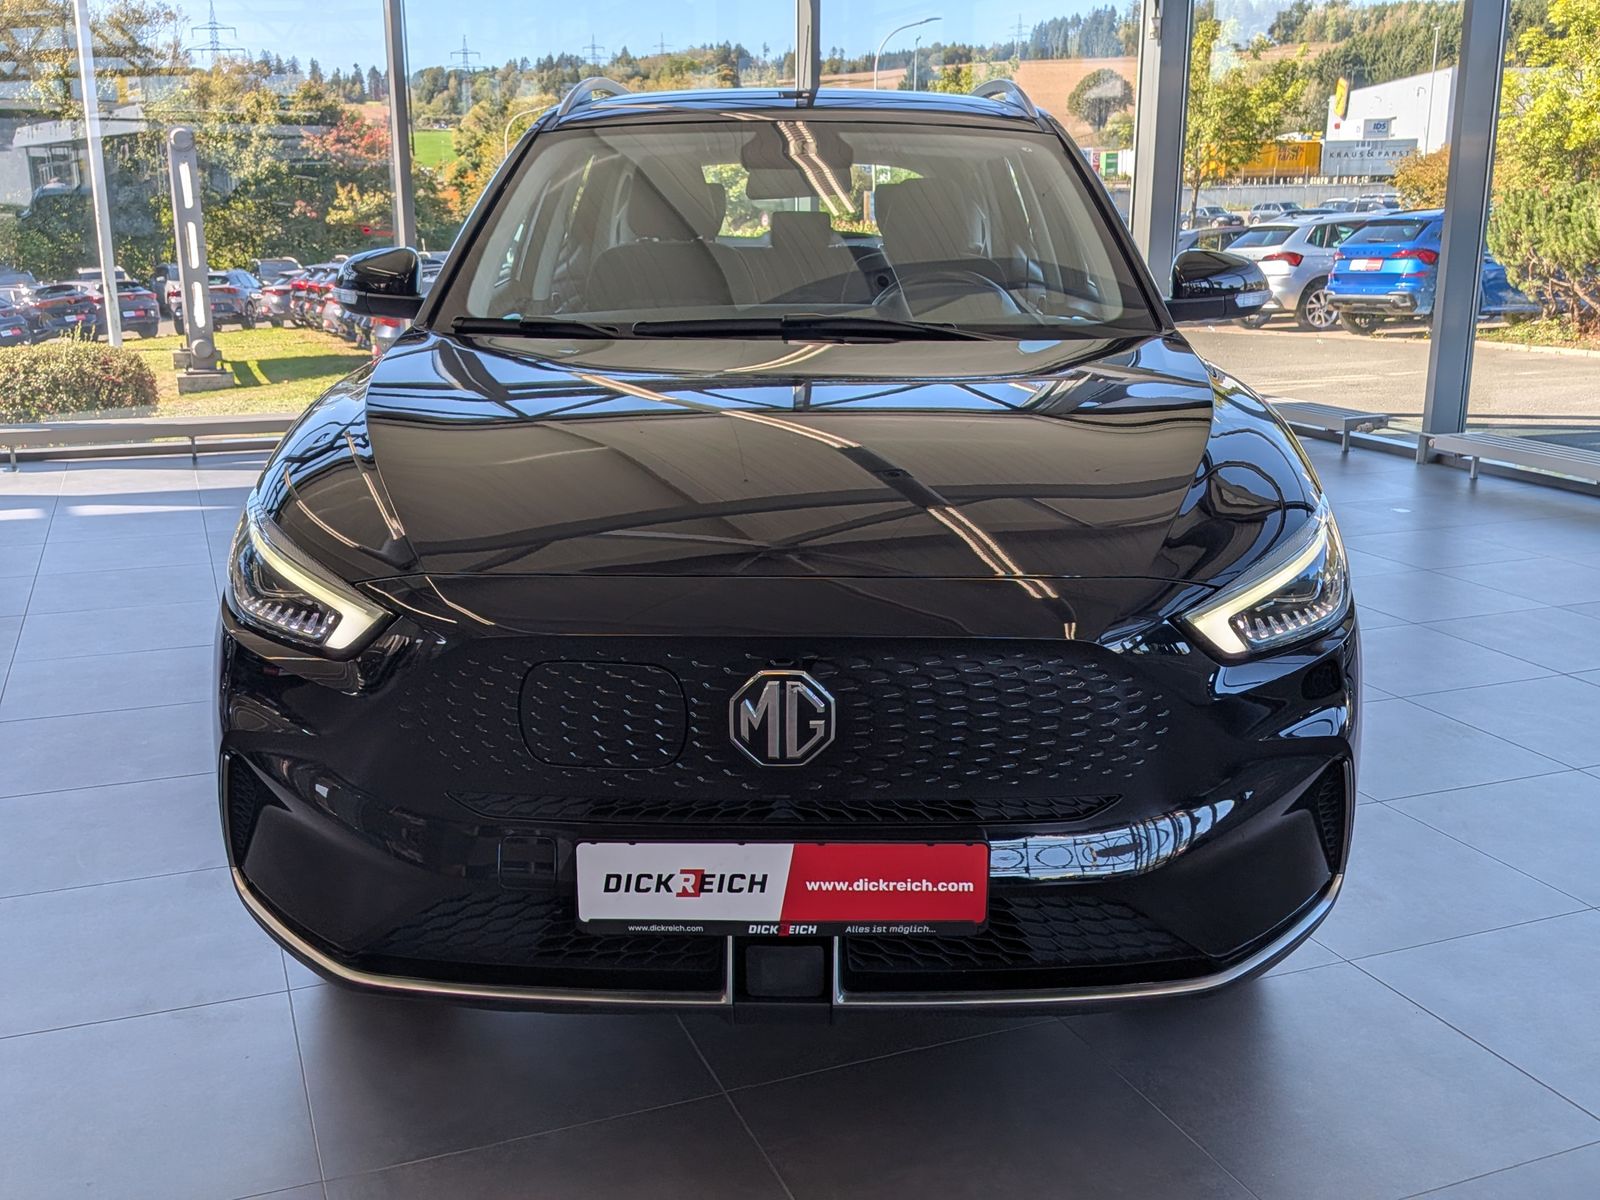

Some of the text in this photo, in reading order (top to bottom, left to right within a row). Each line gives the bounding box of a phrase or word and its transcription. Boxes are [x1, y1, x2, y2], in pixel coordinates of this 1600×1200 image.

[1372, 122, 1387, 130] IDS
[1366, 149, 1374, 158] &
[740, 680, 826, 759] MG
[603, 872, 768, 895] DICKREICH
[805, 878, 974, 892] www.dickreich.com
[627, 924, 704, 933] www.dickreich.com
[748, 924, 818, 935] DICKEICH
[845, 925, 870, 933] Alles
[872, 924, 887, 933] ist
